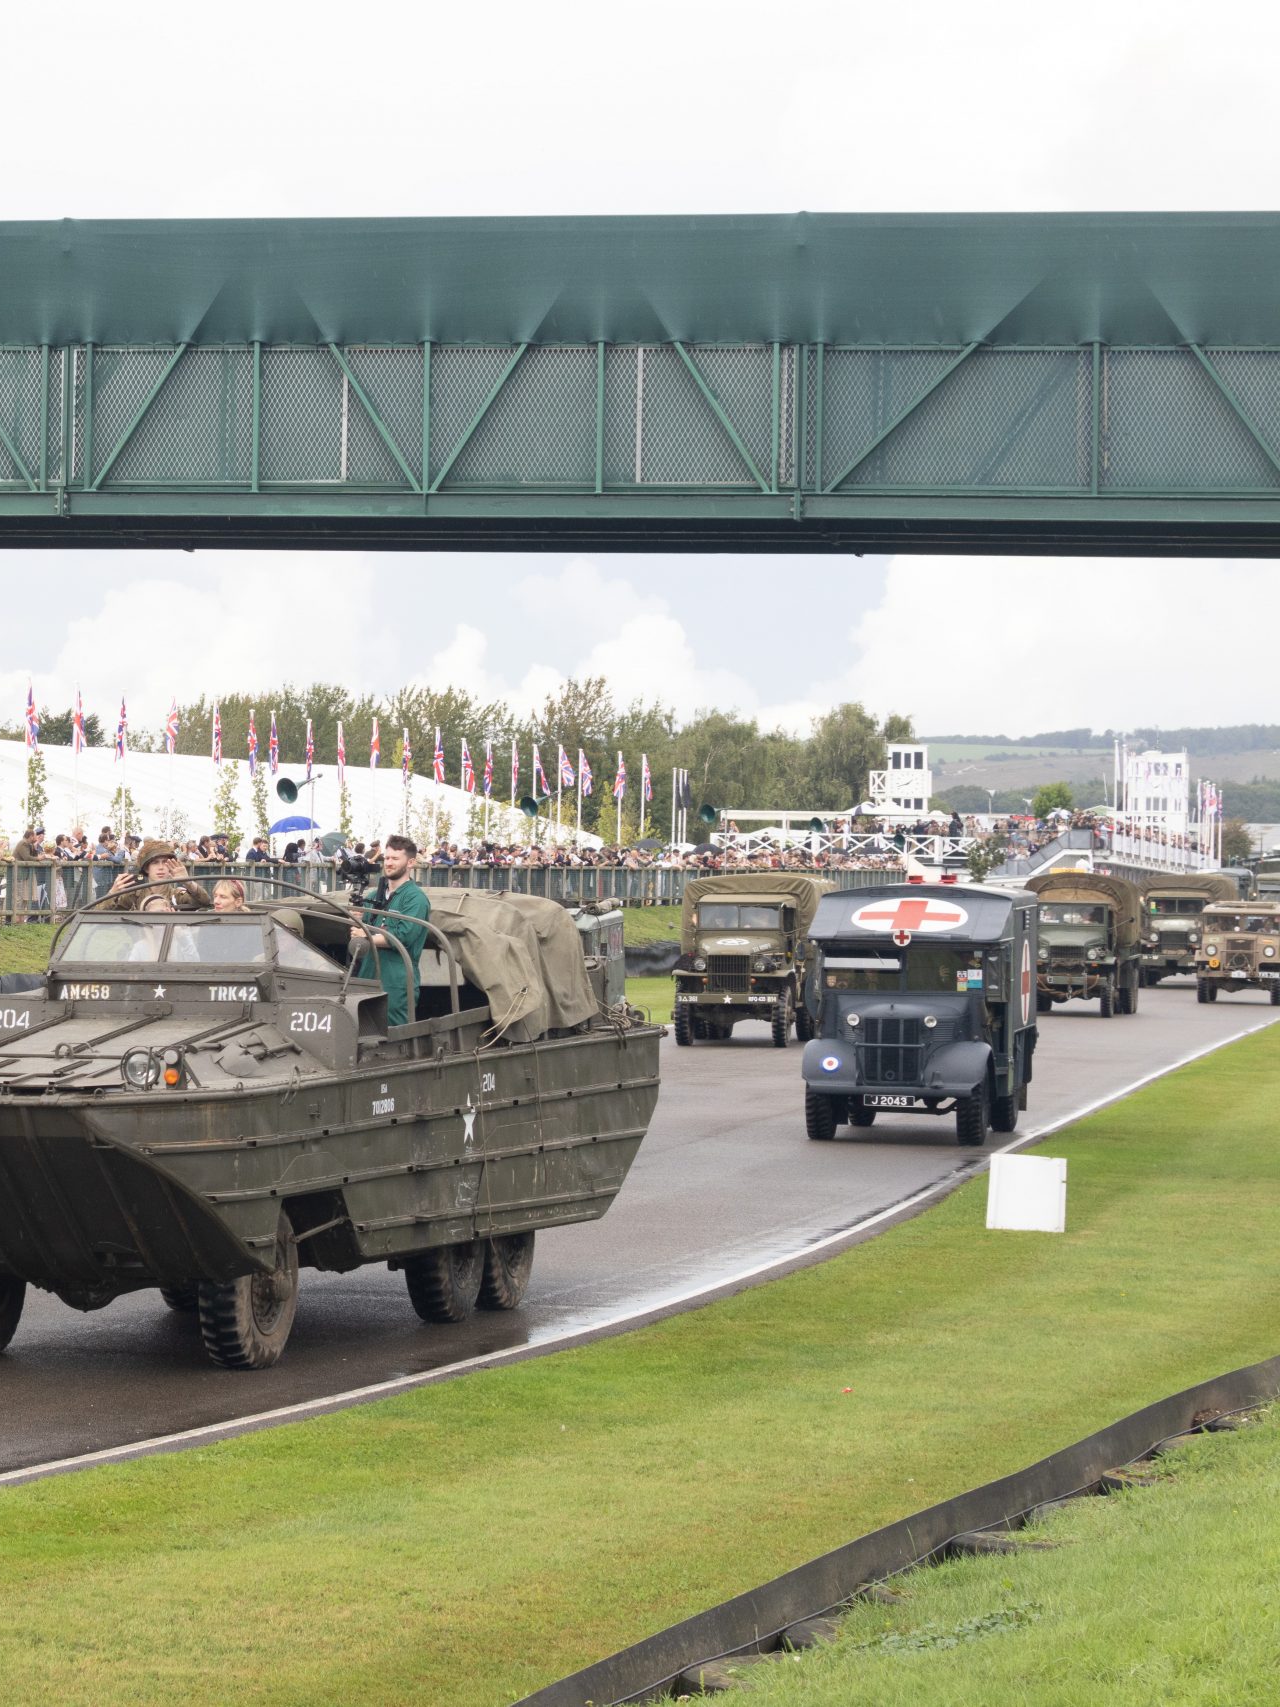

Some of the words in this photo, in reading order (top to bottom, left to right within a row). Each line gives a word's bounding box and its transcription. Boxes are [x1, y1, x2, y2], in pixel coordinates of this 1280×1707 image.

[60, 984, 110, 1000] AM458
[209, 986, 258, 1001] TRK42
[290, 1012, 331, 1032] 204
[482, 1073, 495, 1092] 204
[871, 1095, 878, 1104] J
[880, 1096, 907, 1106] 2043
